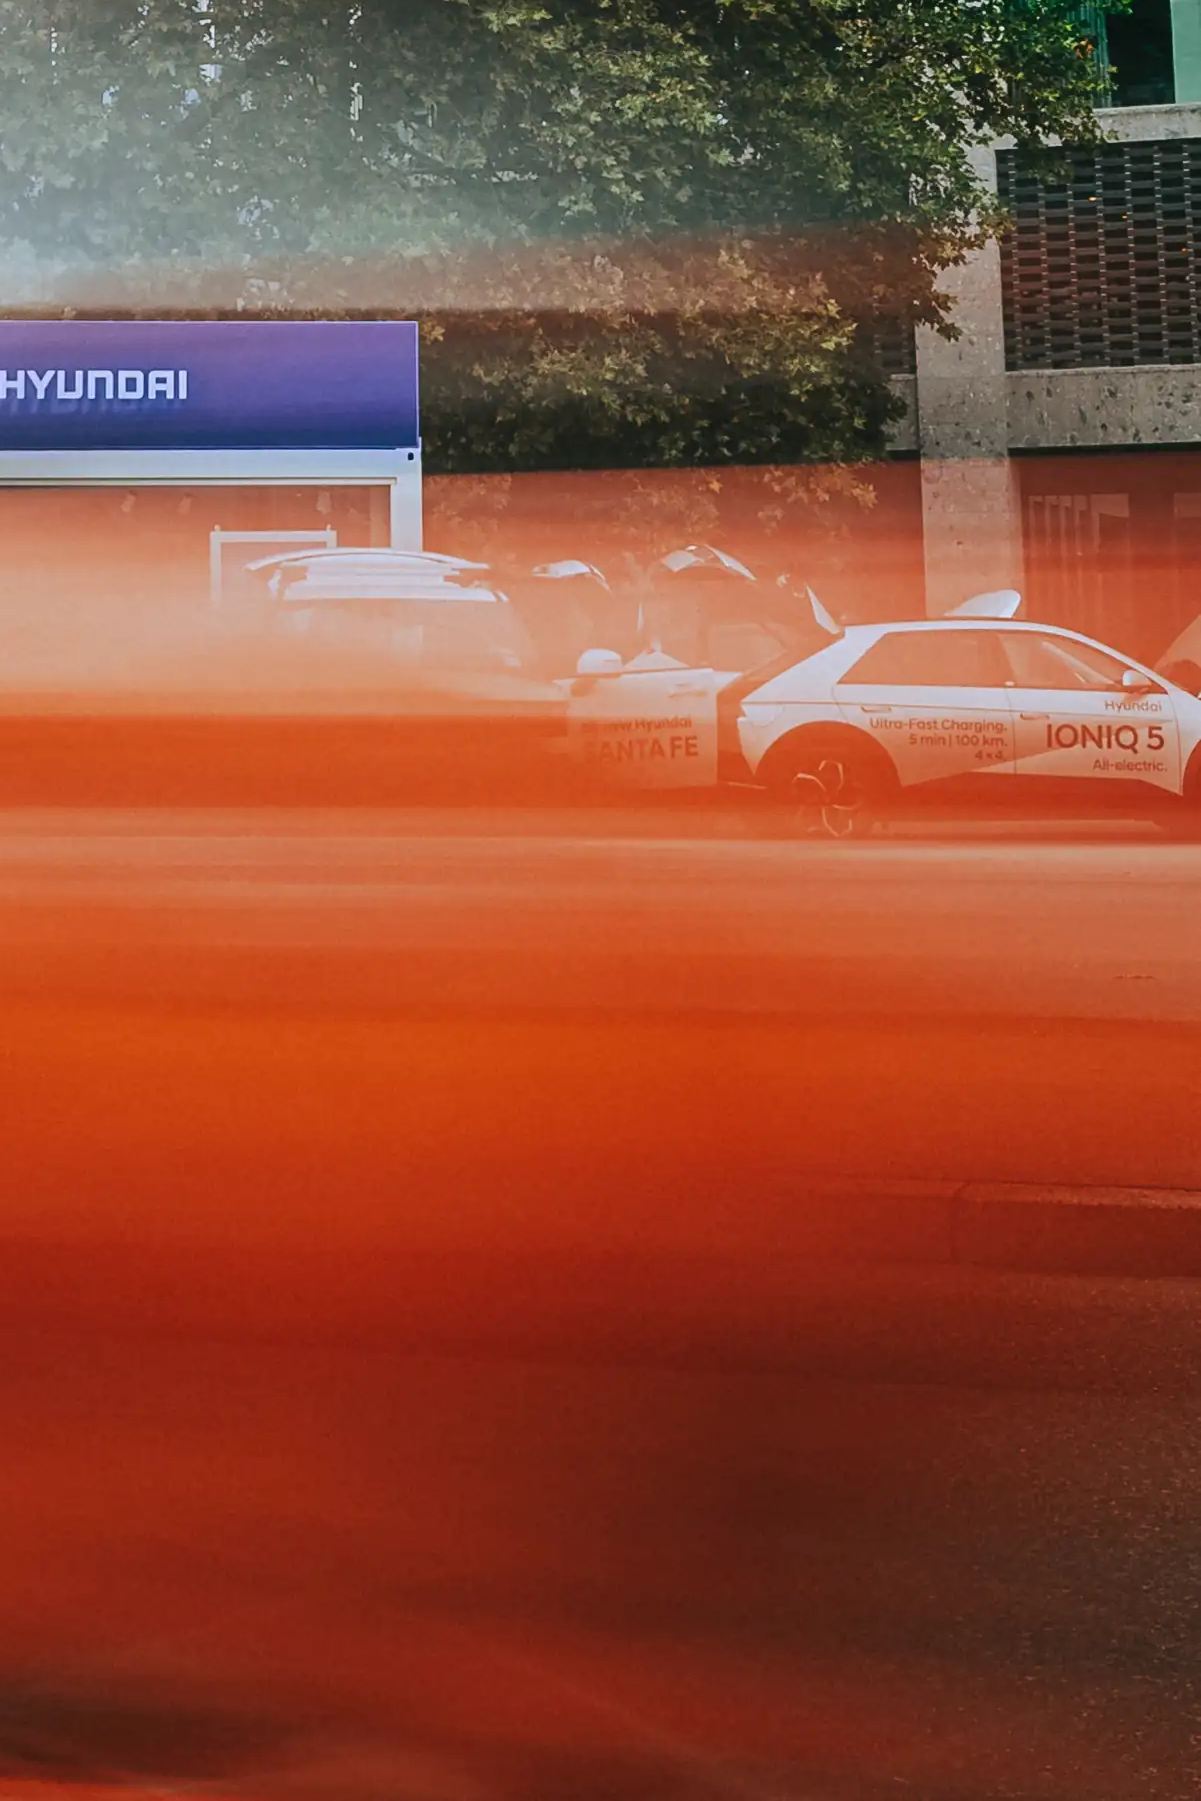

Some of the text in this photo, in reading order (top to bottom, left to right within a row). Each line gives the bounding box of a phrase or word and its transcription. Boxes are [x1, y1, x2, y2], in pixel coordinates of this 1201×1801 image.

[1104, 699, 1162, 713] Hyundai
[635, 715, 693, 733] Hyundai
[869, 717, 1008, 734] Ultra-Fast Charging.
[669, 735, 700, 759] FE
[909, 734, 917, 745] 5
[920, 733, 946, 746] min
[955, 734, 980, 747] 100
[982, 735, 1008, 747] km.
[1046, 723, 1165, 755] IONIQ 5
[1093, 759, 1168, 772] All-electric.
